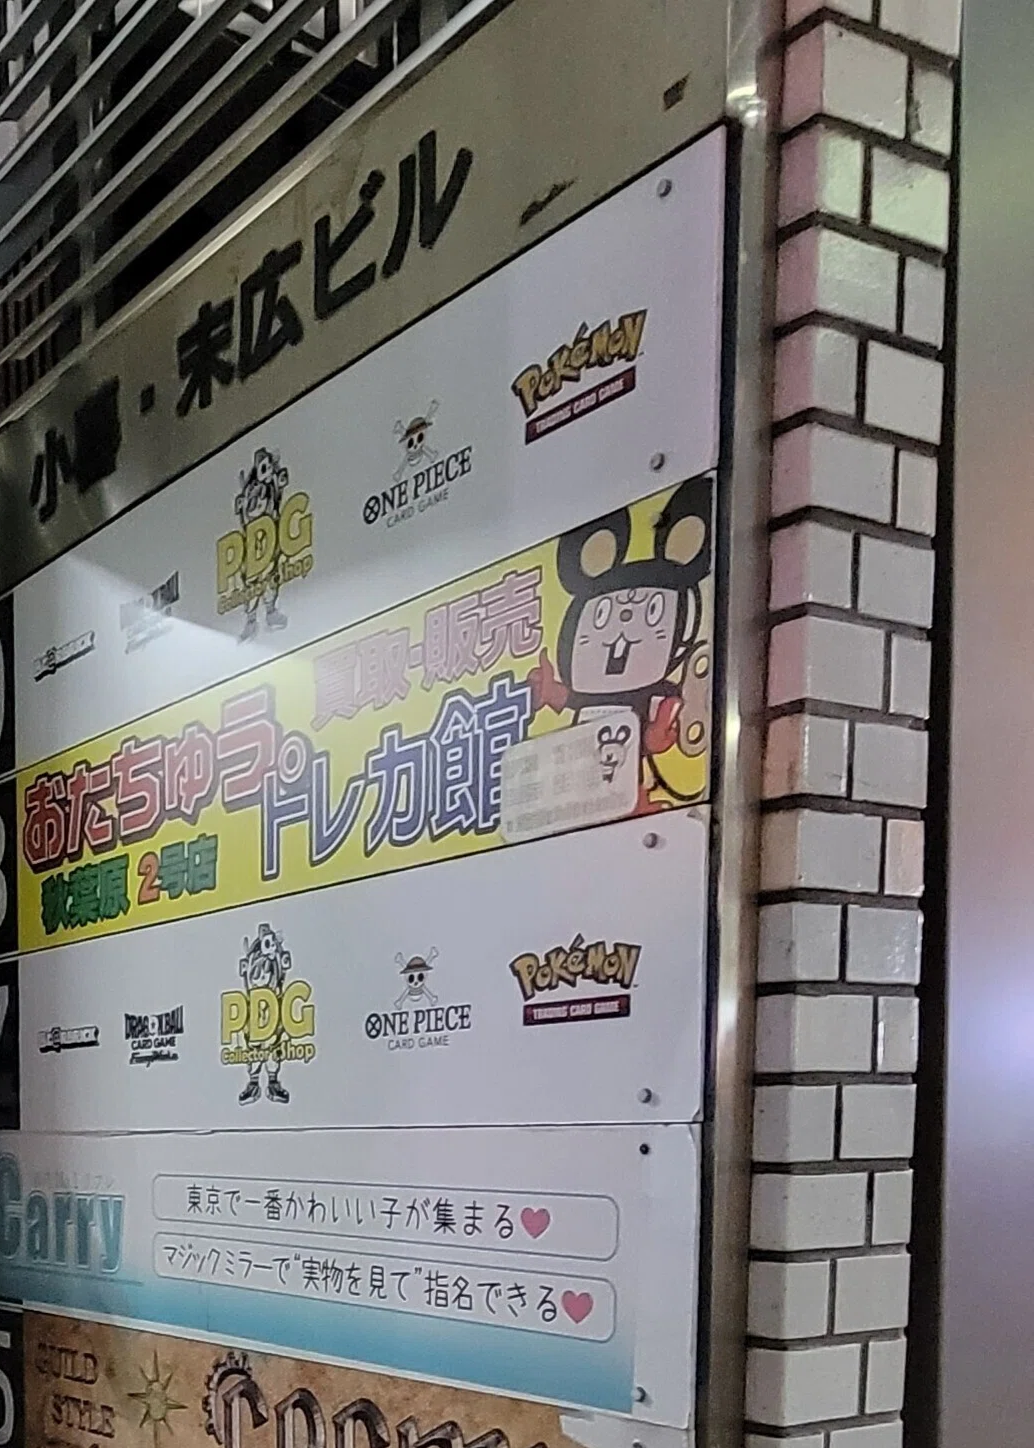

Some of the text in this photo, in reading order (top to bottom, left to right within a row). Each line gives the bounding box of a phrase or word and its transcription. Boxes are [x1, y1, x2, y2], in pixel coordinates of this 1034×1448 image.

[363, 446, 472, 525] ONE PIECE
[386, 487, 450, 528] CARD GAME
[217, 491, 312, 594] PDG
[221, 980, 315, 1045] PDG
[366, 1004, 471, 1039] ONE PIECE
[387, 1035, 449, 1050] CARD GAME
